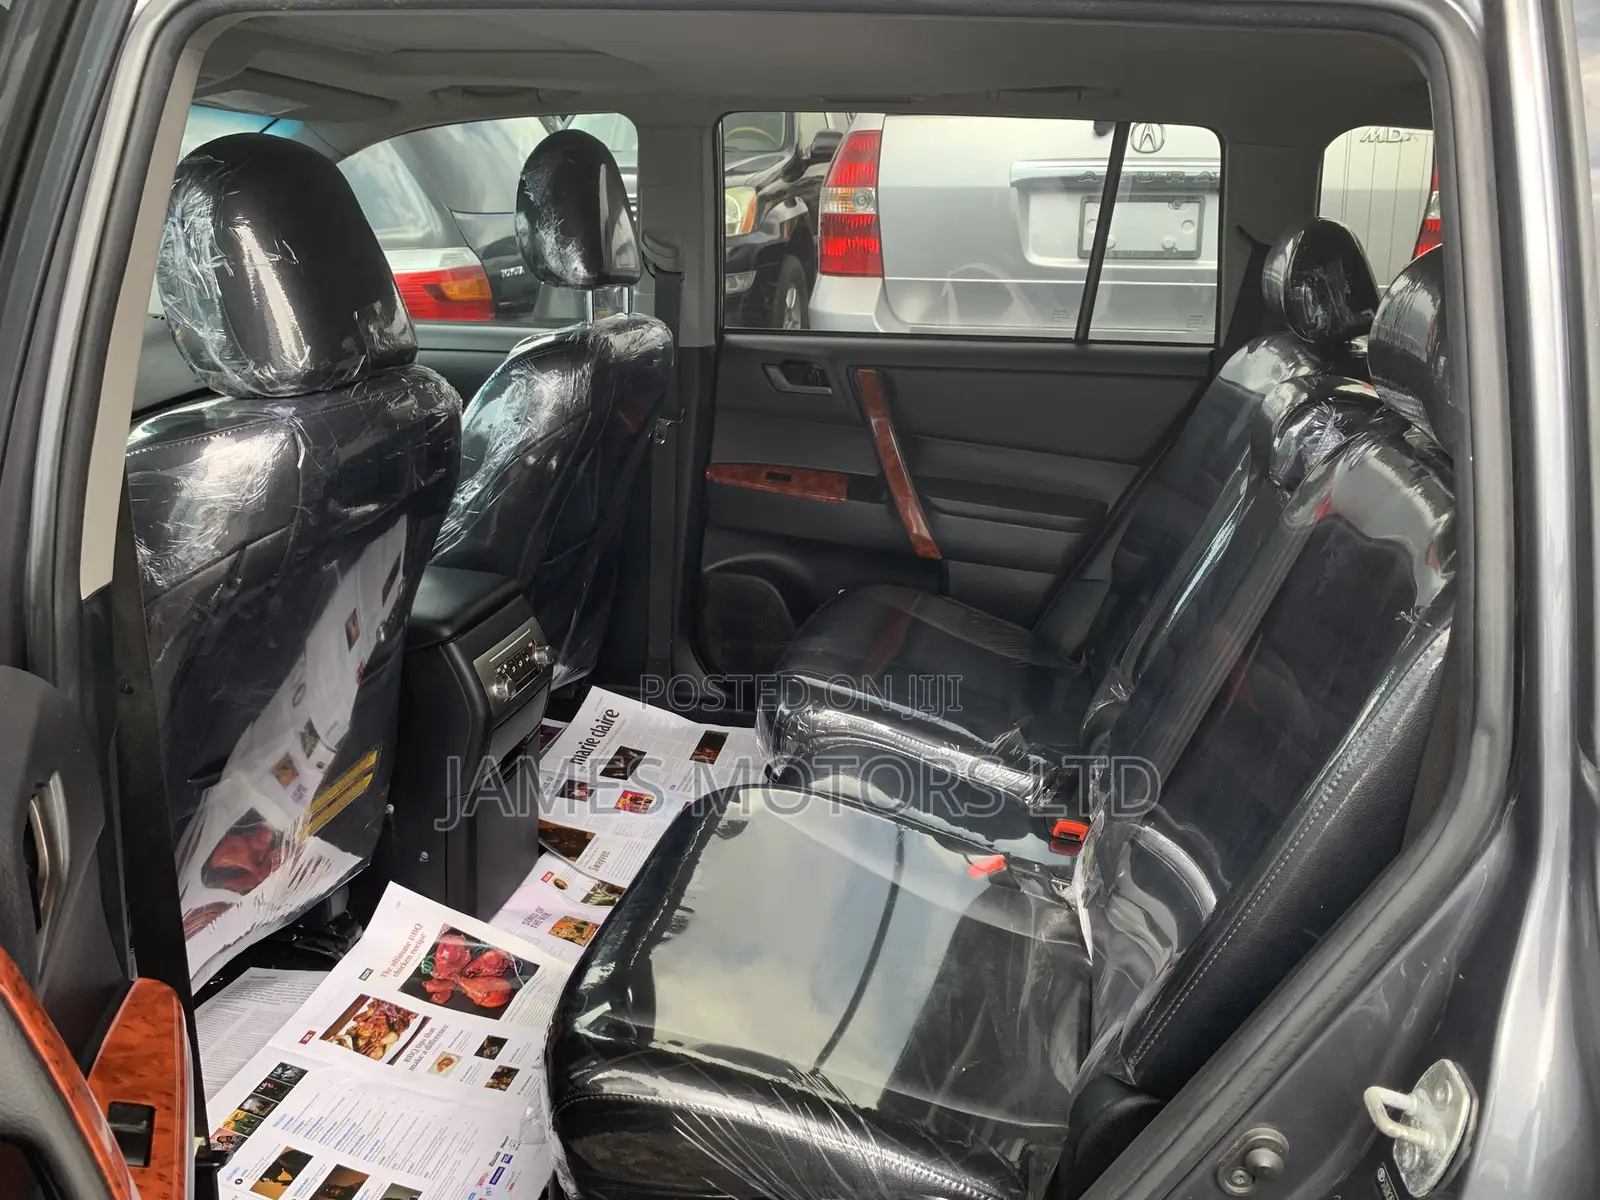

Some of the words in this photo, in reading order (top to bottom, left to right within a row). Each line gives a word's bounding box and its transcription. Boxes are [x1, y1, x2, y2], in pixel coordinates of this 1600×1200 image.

[500, 265, 525, 278] TOYOTA
[569, 737, 600, 765] marie
[590, 709, 620, 738] claire
[380, 963, 393, 978] The
[391, 943, 412, 967] ultimate
[408, 923, 423, 942] BBQ
[393, 954, 413, 978] chicken
[410, 933, 427, 955] recipe
[403, 1047, 417, 1063] BBQ
[415, 1037, 427, 1050] tips
[424, 1027, 437, 1039] that
[409, 1057, 424, 1072] make
